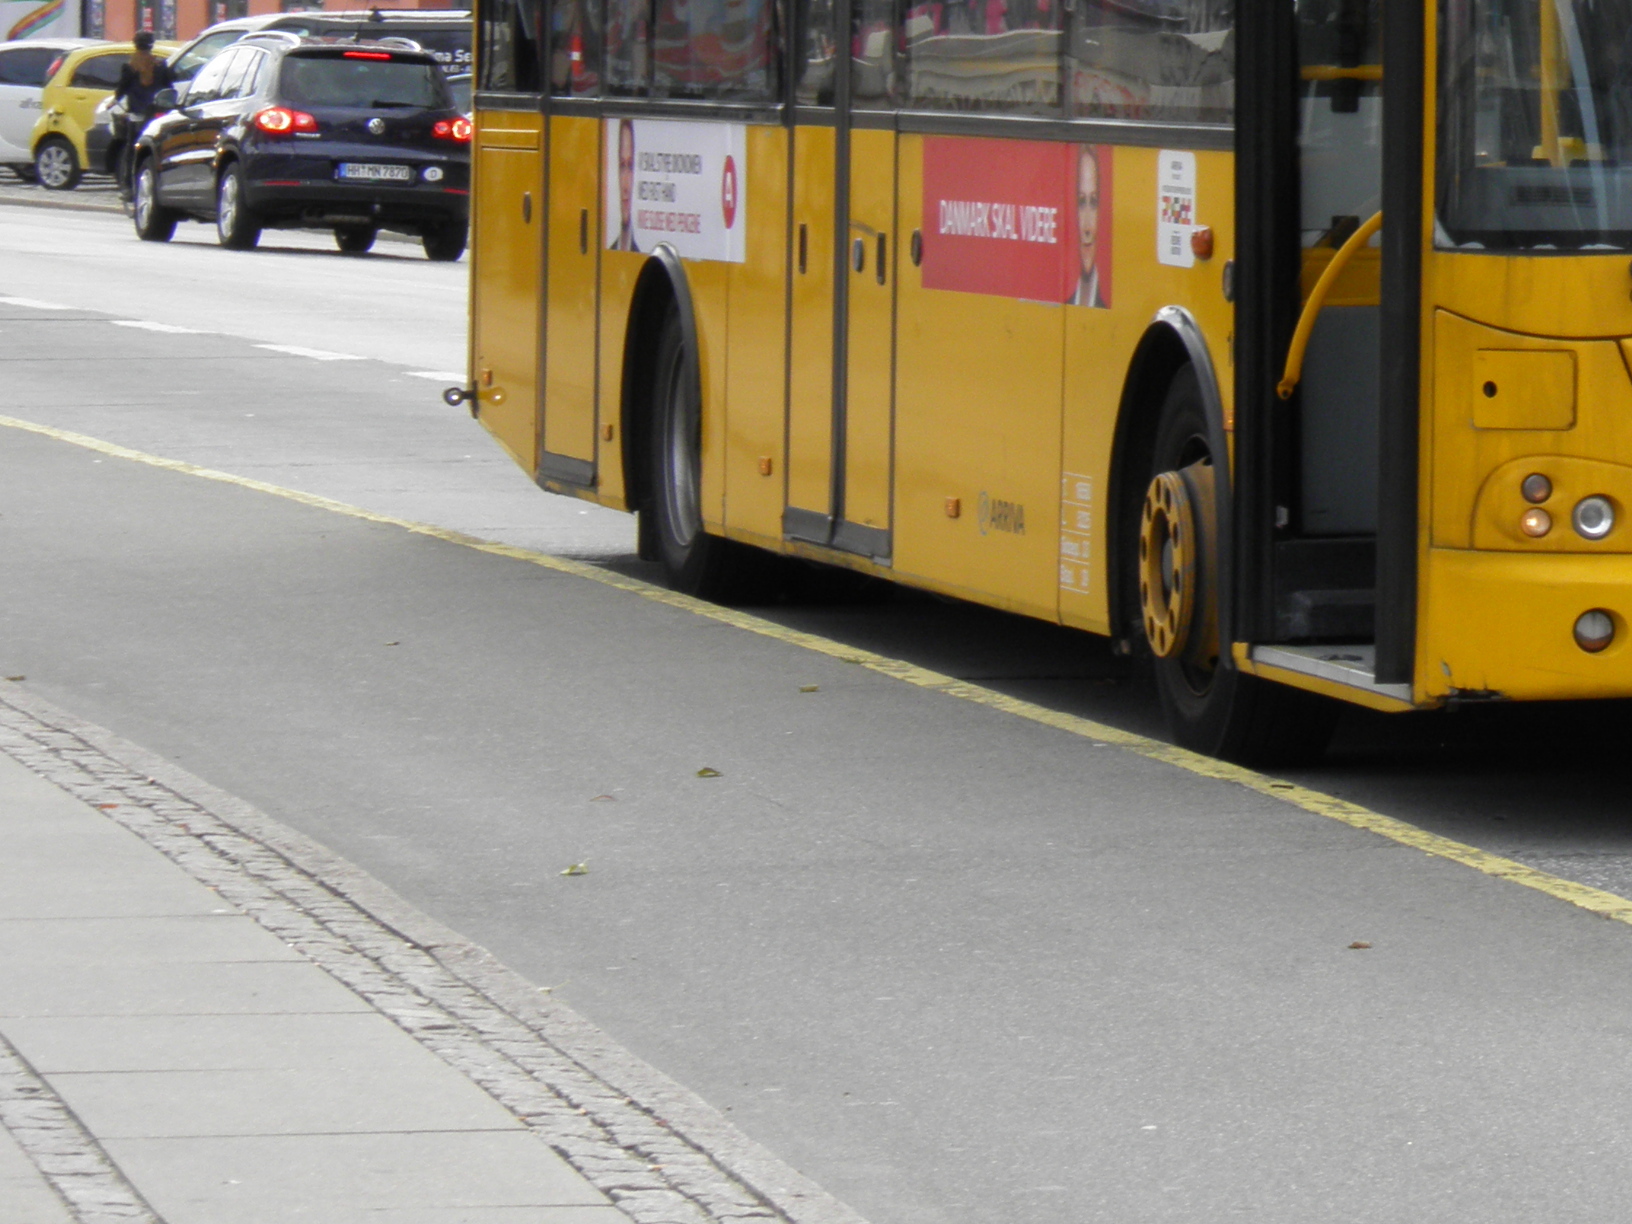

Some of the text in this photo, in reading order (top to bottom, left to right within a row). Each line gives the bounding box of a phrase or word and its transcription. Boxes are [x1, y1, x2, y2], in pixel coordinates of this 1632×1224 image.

[939, 199, 1058, 244] DANMARK SKAL VIDERE
[990, 498, 1025, 536] ARRIVA
